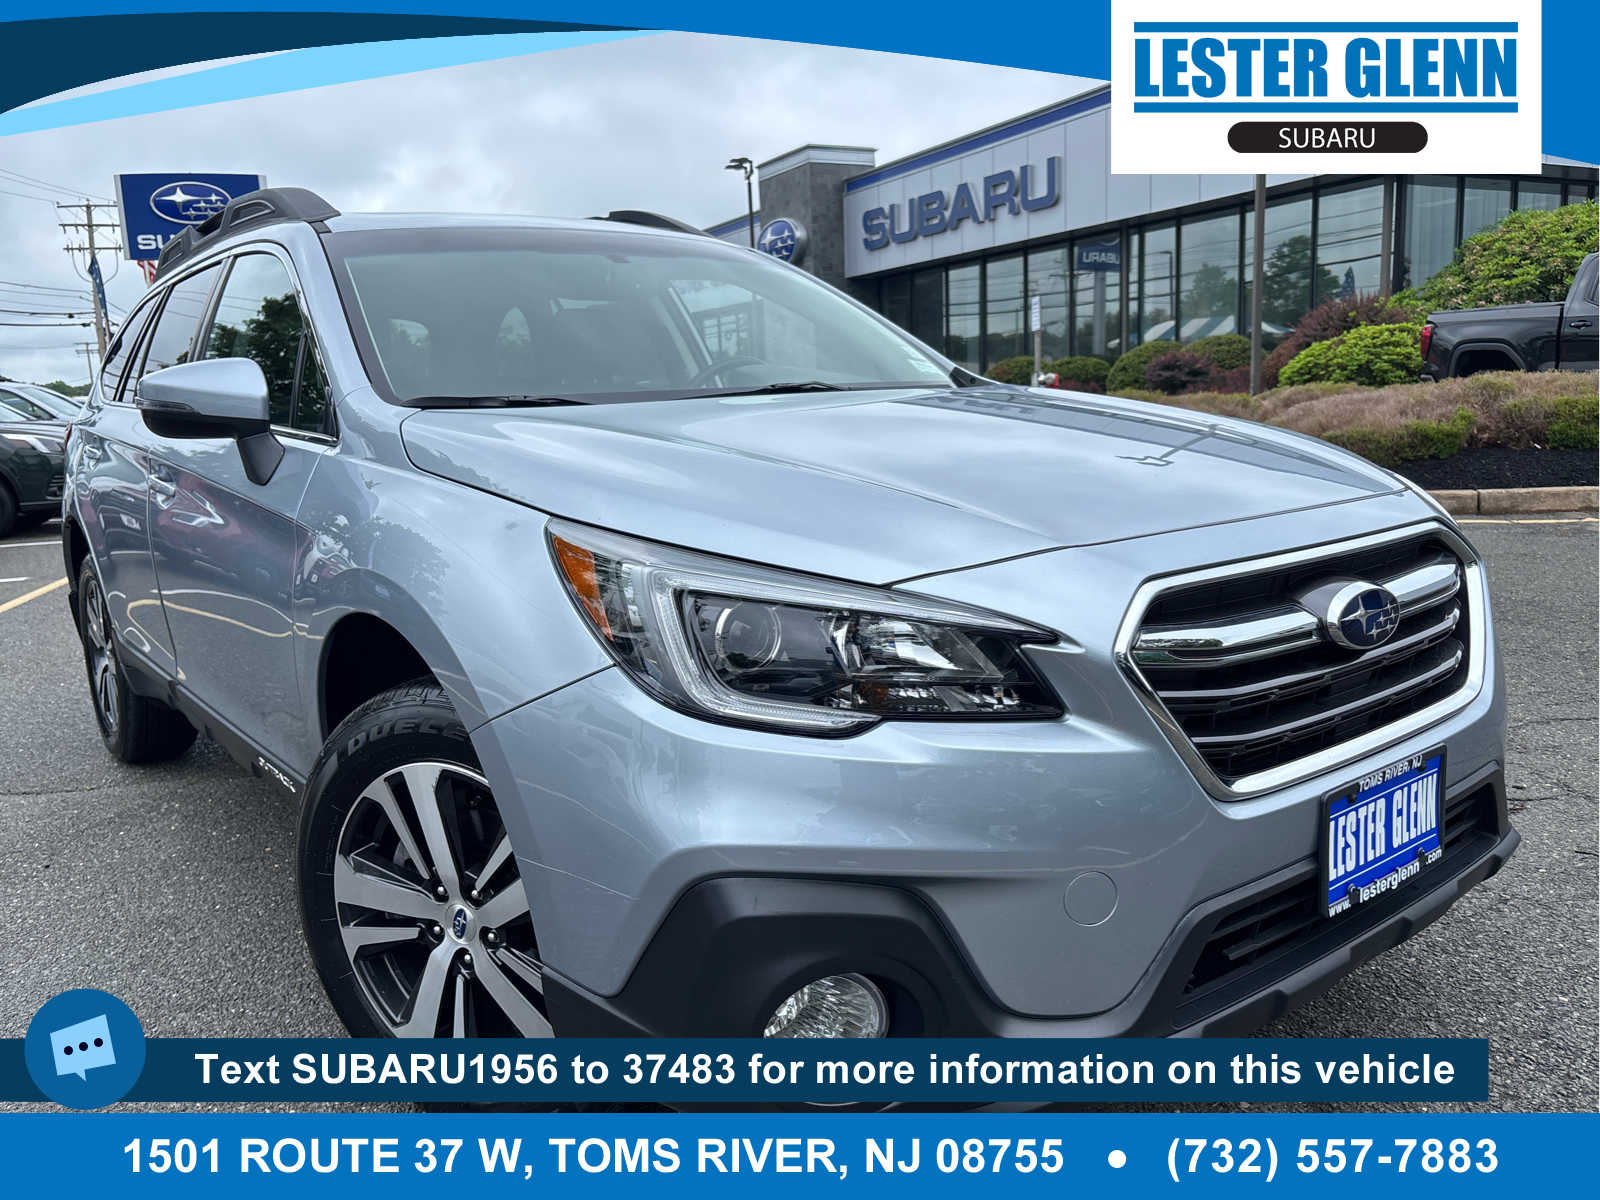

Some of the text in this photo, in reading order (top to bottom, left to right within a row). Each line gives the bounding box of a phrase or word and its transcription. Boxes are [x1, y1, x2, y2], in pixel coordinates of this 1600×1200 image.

[861, 156, 1062, 252] SUBARU
[1359, 772, 1384, 793] TOMS
[1411, 754, 1423, 769] NJ
[1328, 773, 1438, 882] LESTER GLENN
